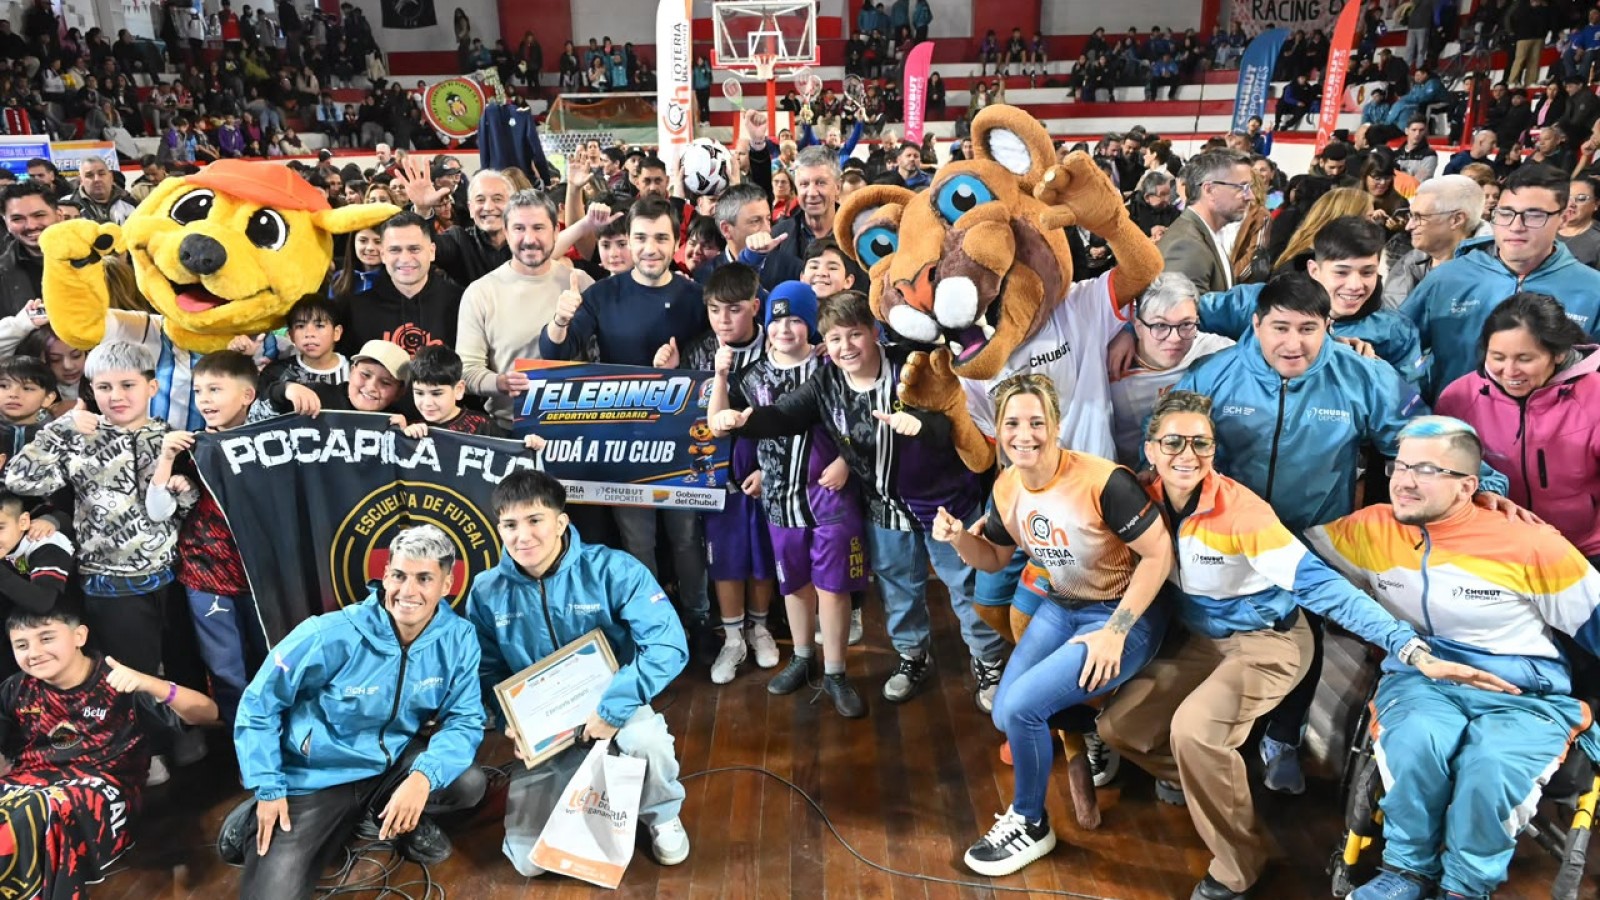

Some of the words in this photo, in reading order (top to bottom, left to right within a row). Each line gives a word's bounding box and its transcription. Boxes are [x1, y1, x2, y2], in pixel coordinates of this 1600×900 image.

[1252, 0, 1321, 22] RACING
[673, 22, 682, 82] LOTERIA
[1237, 64, 1257, 125] CHUBUT
[1323, 48, 1341, 123] CHUBUT
[908, 75, 918, 129] CHUBUT
[520, 376, 692, 416] TELEBINGO
[546, 412, 598, 421] DEPORTIVO
[599, 411, 649, 420] SOLIDARIO
[219, 427, 442, 475] POCAPILA
[544, 436, 585, 463] UDÁ
[585, 440, 598, 463] A
[604, 440, 627, 463] TU
[628, 440, 676, 463] CLUB
[564, 485, 585, 494] ERIA
[604, 495, 644, 503] DEPORTES
[605, 487, 644, 495] CHUBUT
[675, 490, 712, 499] Gobierno
[675, 498, 688, 506] del
[689, 498, 718, 507] Chubut
[104, 506, 140, 537] GAME
[112, 518, 150, 548] KING
[422, 494, 445, 512] DE
[443, 502, 486, 550] FUTSAL
[1034, 548, 1073, 560] OTERIA
[1464, 588, 1501, 596] CHUBUT
